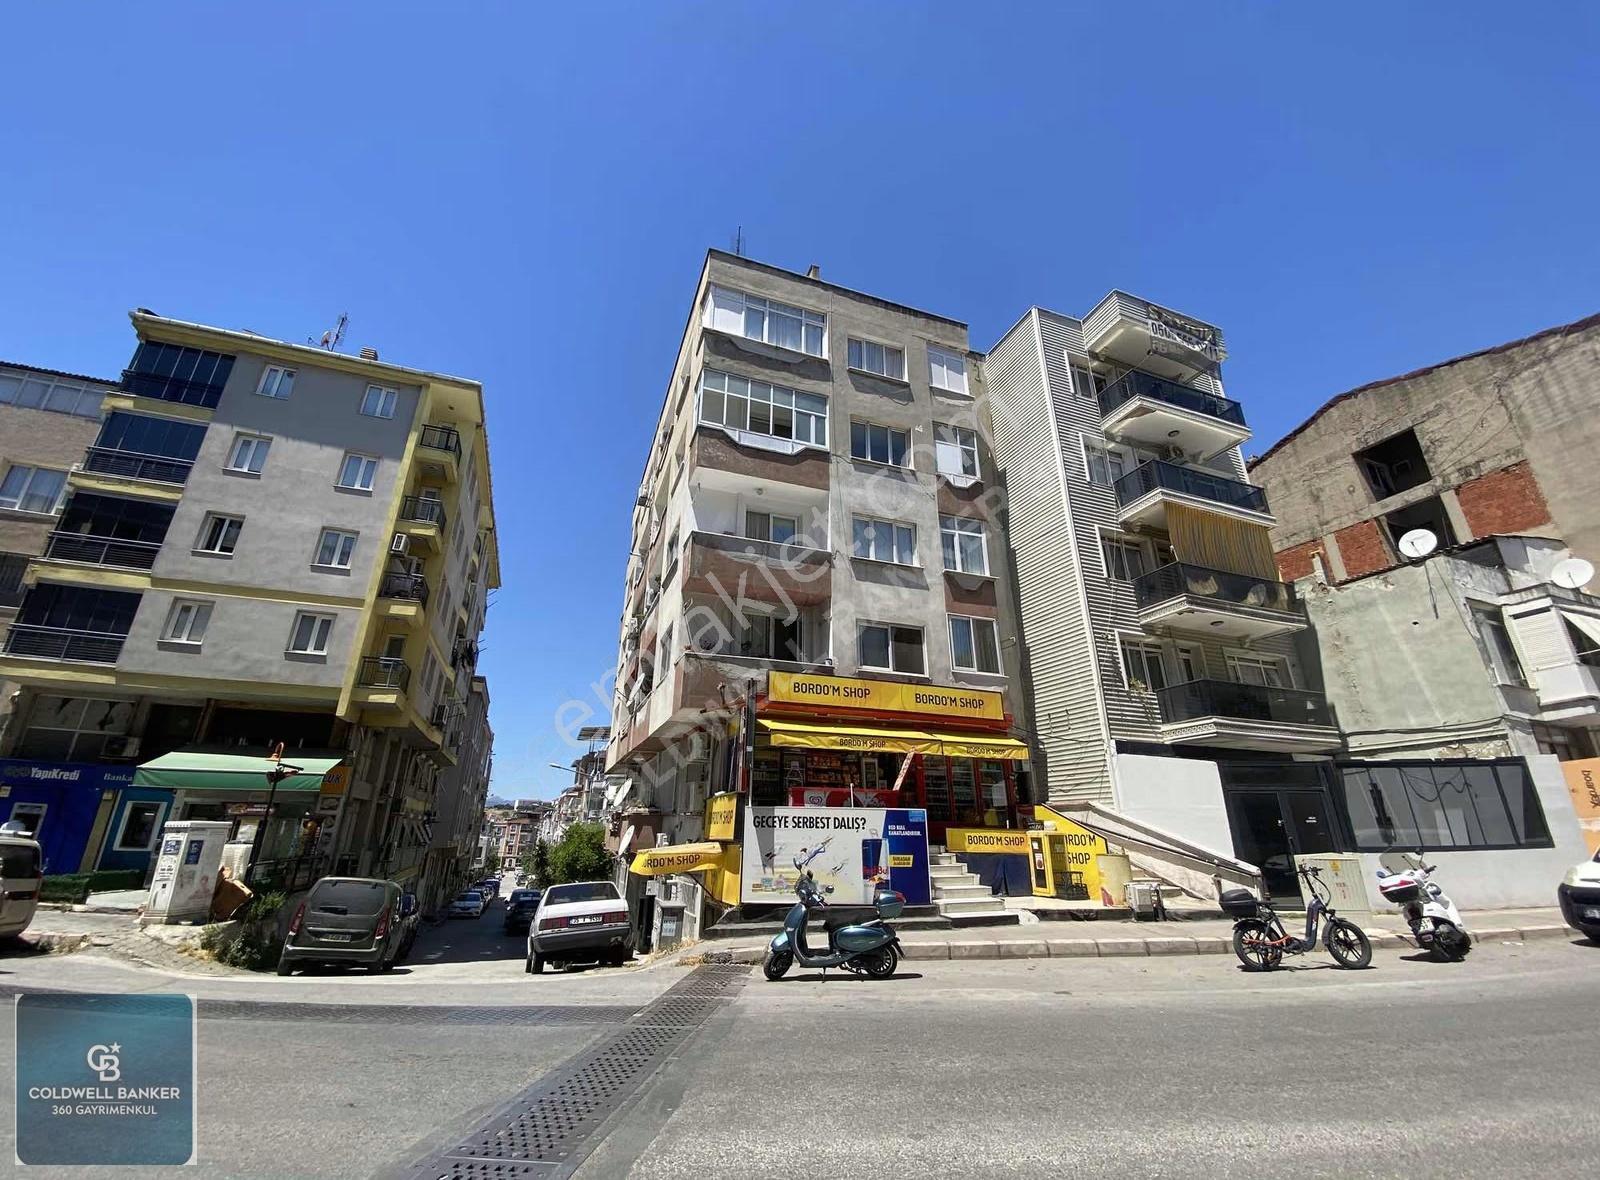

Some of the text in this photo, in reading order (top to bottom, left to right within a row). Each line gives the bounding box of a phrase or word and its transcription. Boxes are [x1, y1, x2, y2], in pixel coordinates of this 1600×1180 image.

[793, 682, 871, 699] BORDO'M SHOP
[915, 693, 984, 710] BORDO'M SHOP
[869, 740, 886, 748] SHOP
[753, 815, 867, 833] GECEYE SERBEST DALIŞ?
[967, 835, 1025, 846] BORDO'M SHOP
[676, 854, 701, 866] SHOP
